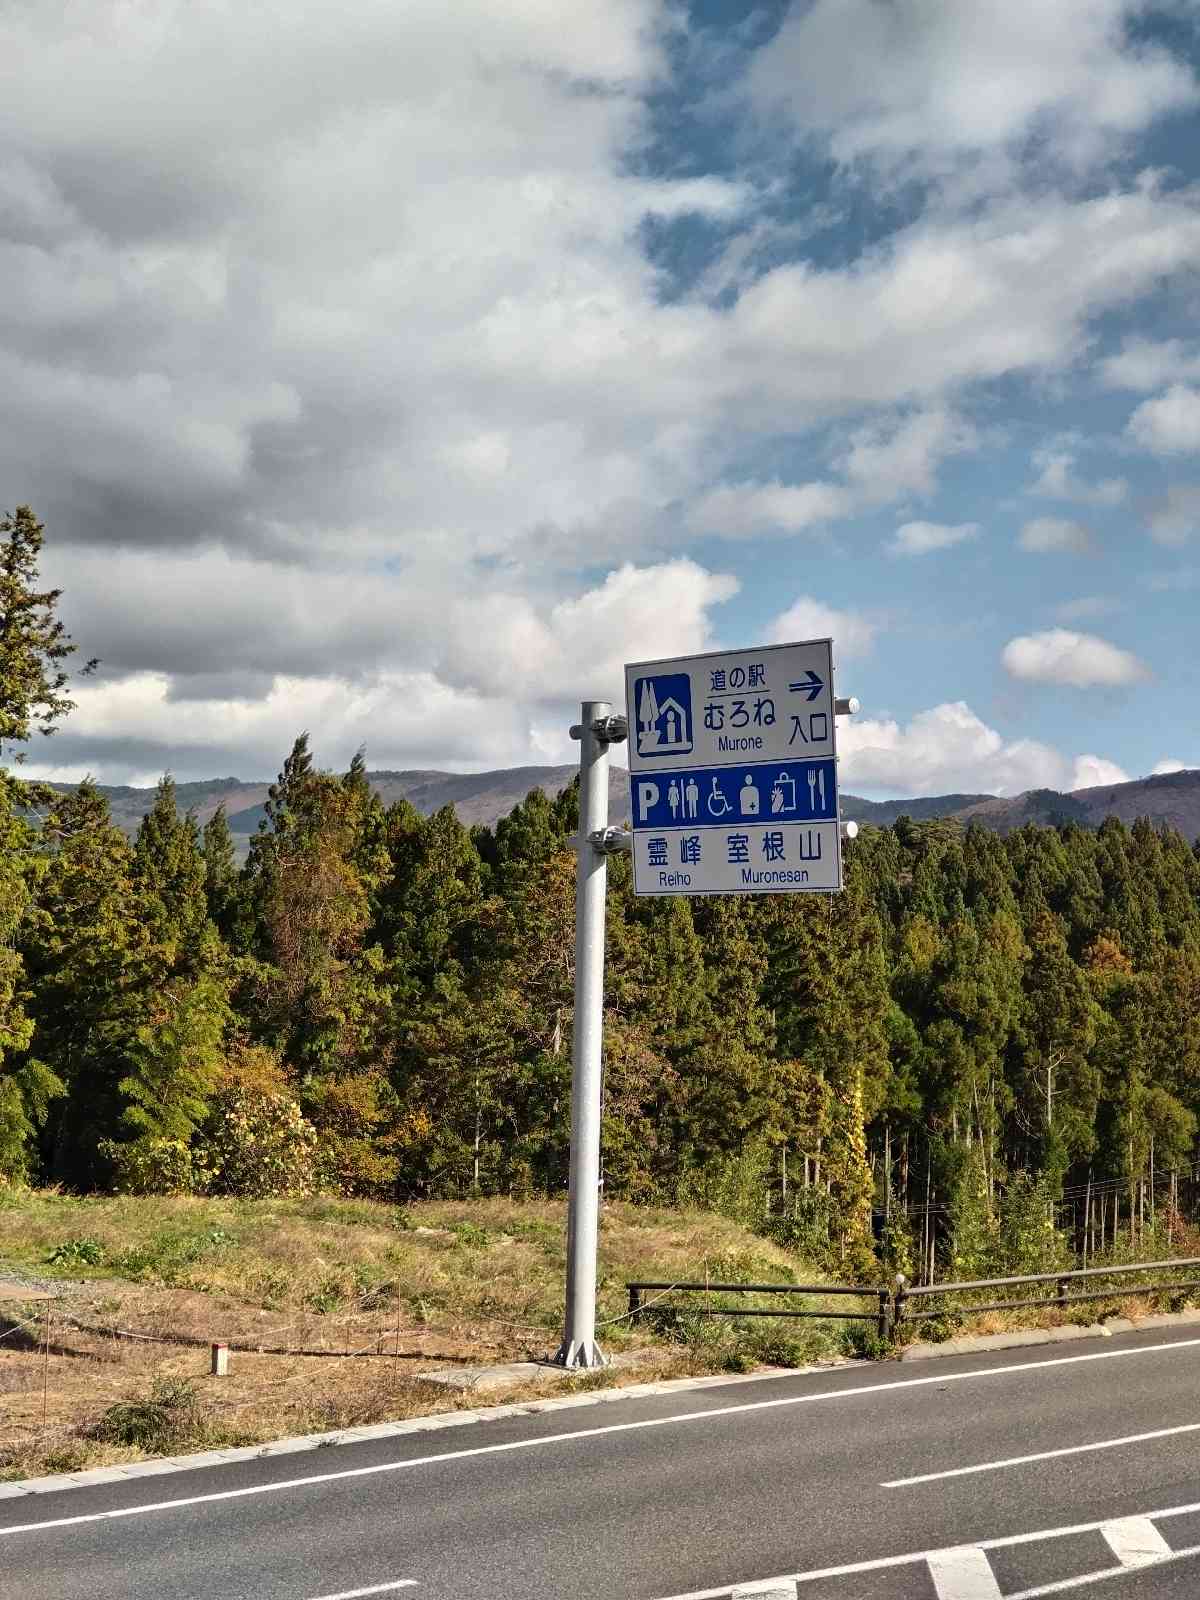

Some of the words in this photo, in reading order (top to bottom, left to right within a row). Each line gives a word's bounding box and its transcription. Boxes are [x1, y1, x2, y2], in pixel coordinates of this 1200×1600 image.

[710, 663, 766, 692] 道の駅
[703, 698, 776, 731] むろね
[788, 712, 828, 745] 入口
[718, 735, 763, 752] Murone
[638, 782, 660, 821] P
[647, 835, 702, 866] 霊峰
[727, 830, 822, 864] 室根山
[659, 871, 691, 887] Reiho
[742, 868, 809, 884] Muronesan
